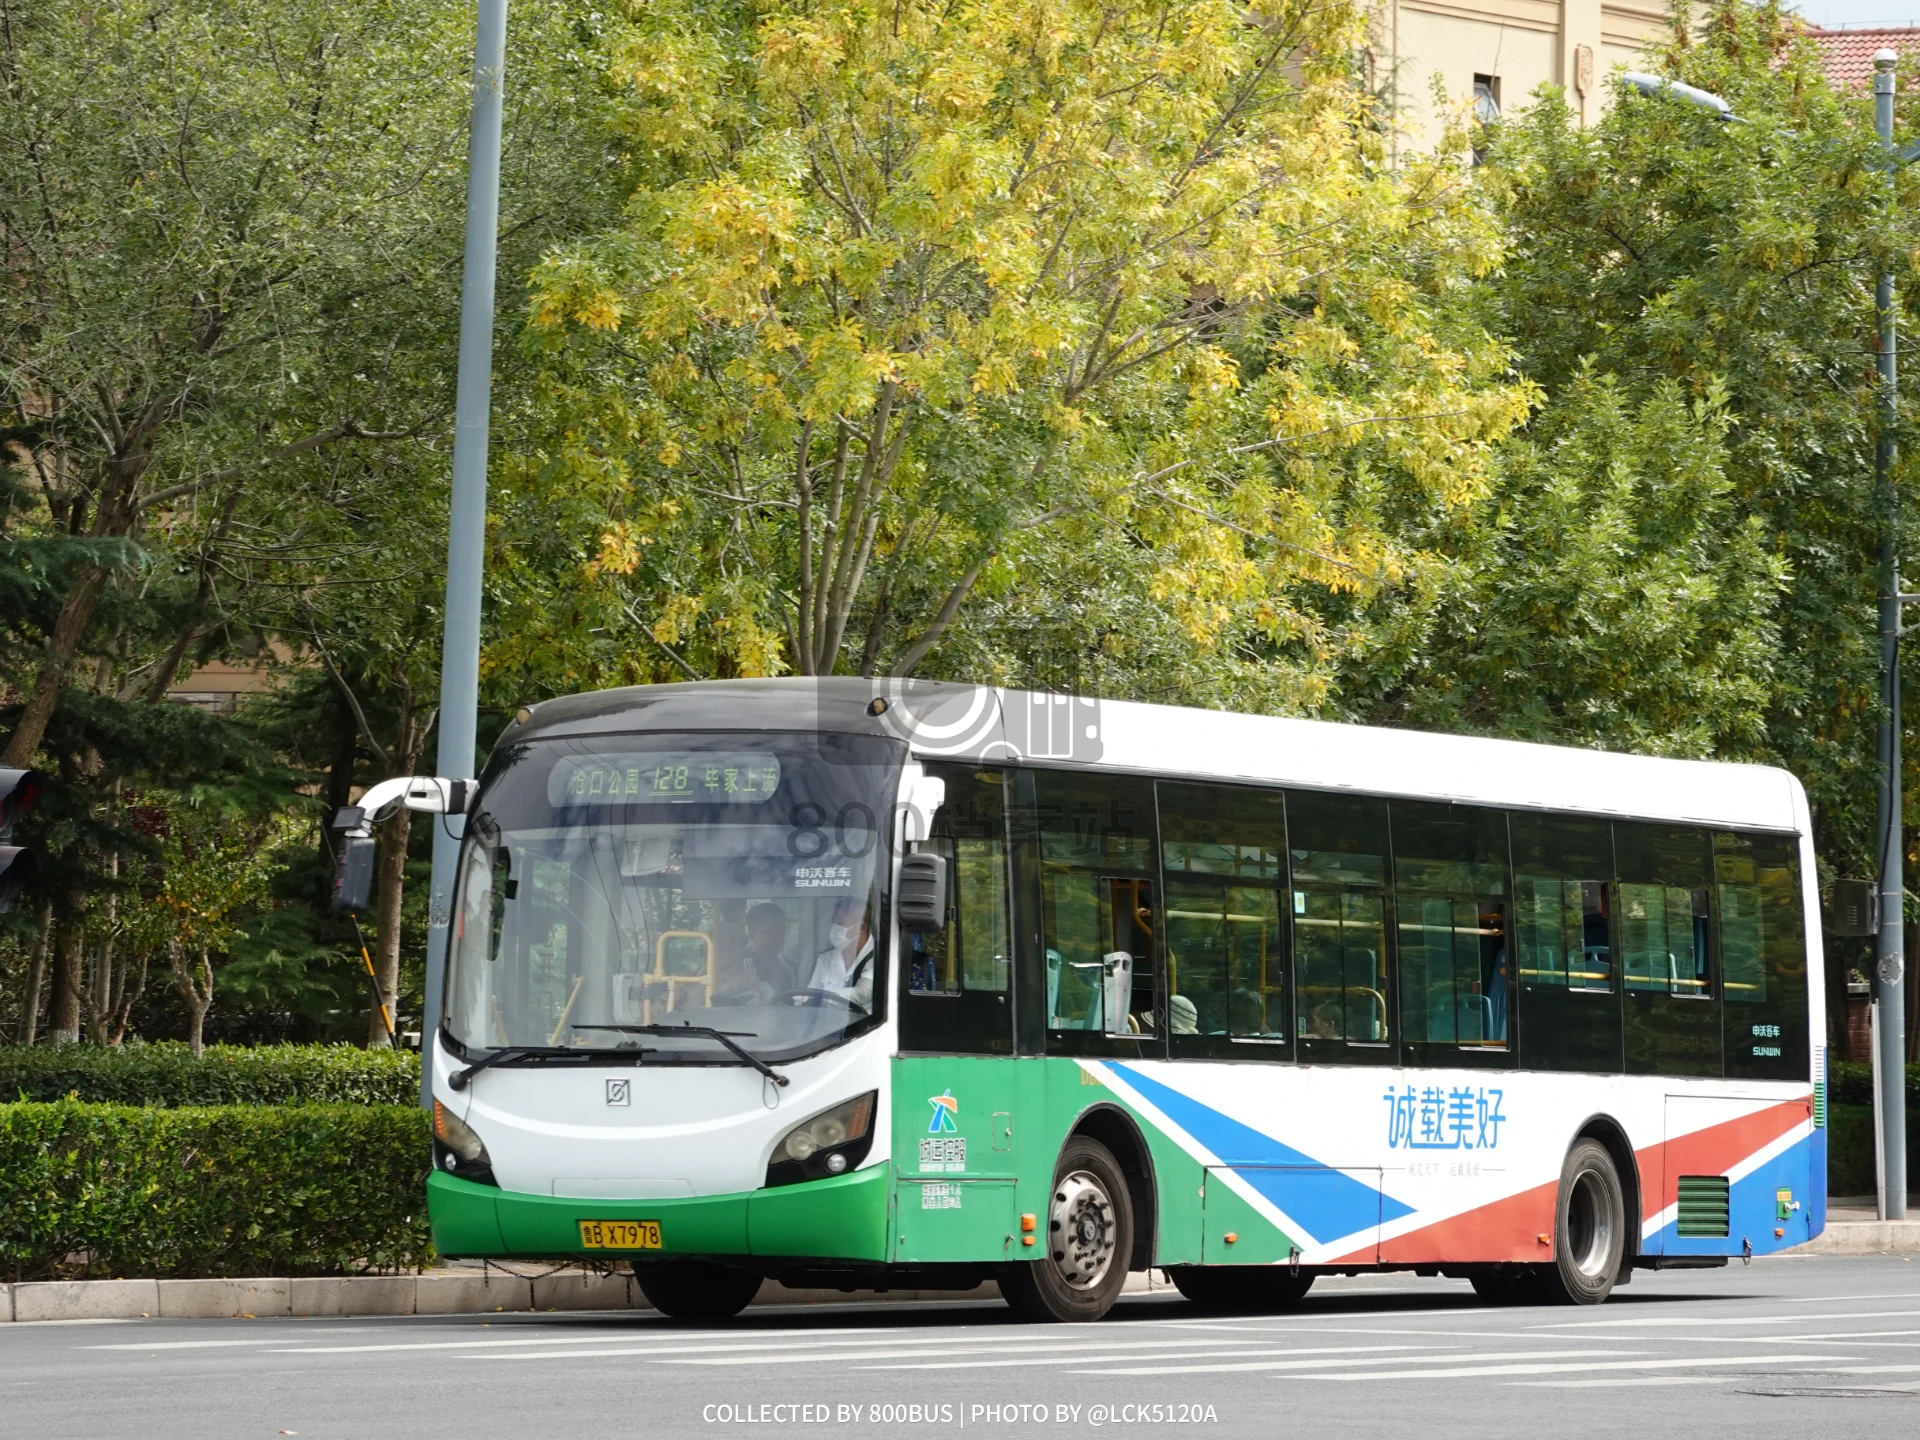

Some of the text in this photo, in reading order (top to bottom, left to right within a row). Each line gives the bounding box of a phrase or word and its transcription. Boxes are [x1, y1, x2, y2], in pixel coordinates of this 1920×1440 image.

[571, 766, 776, 795] 沧口公园 128 毕家上流
[795, 867, 851, 879] 申沃客车
[795, 879, 851, 887] SUNWIN
[1752, 1025, 1780, 1037] 申沃客车
[1752, 1046, 1781, 1056] SUNWIN
[1383, 1085, 1506, 1149] 诚载美好
